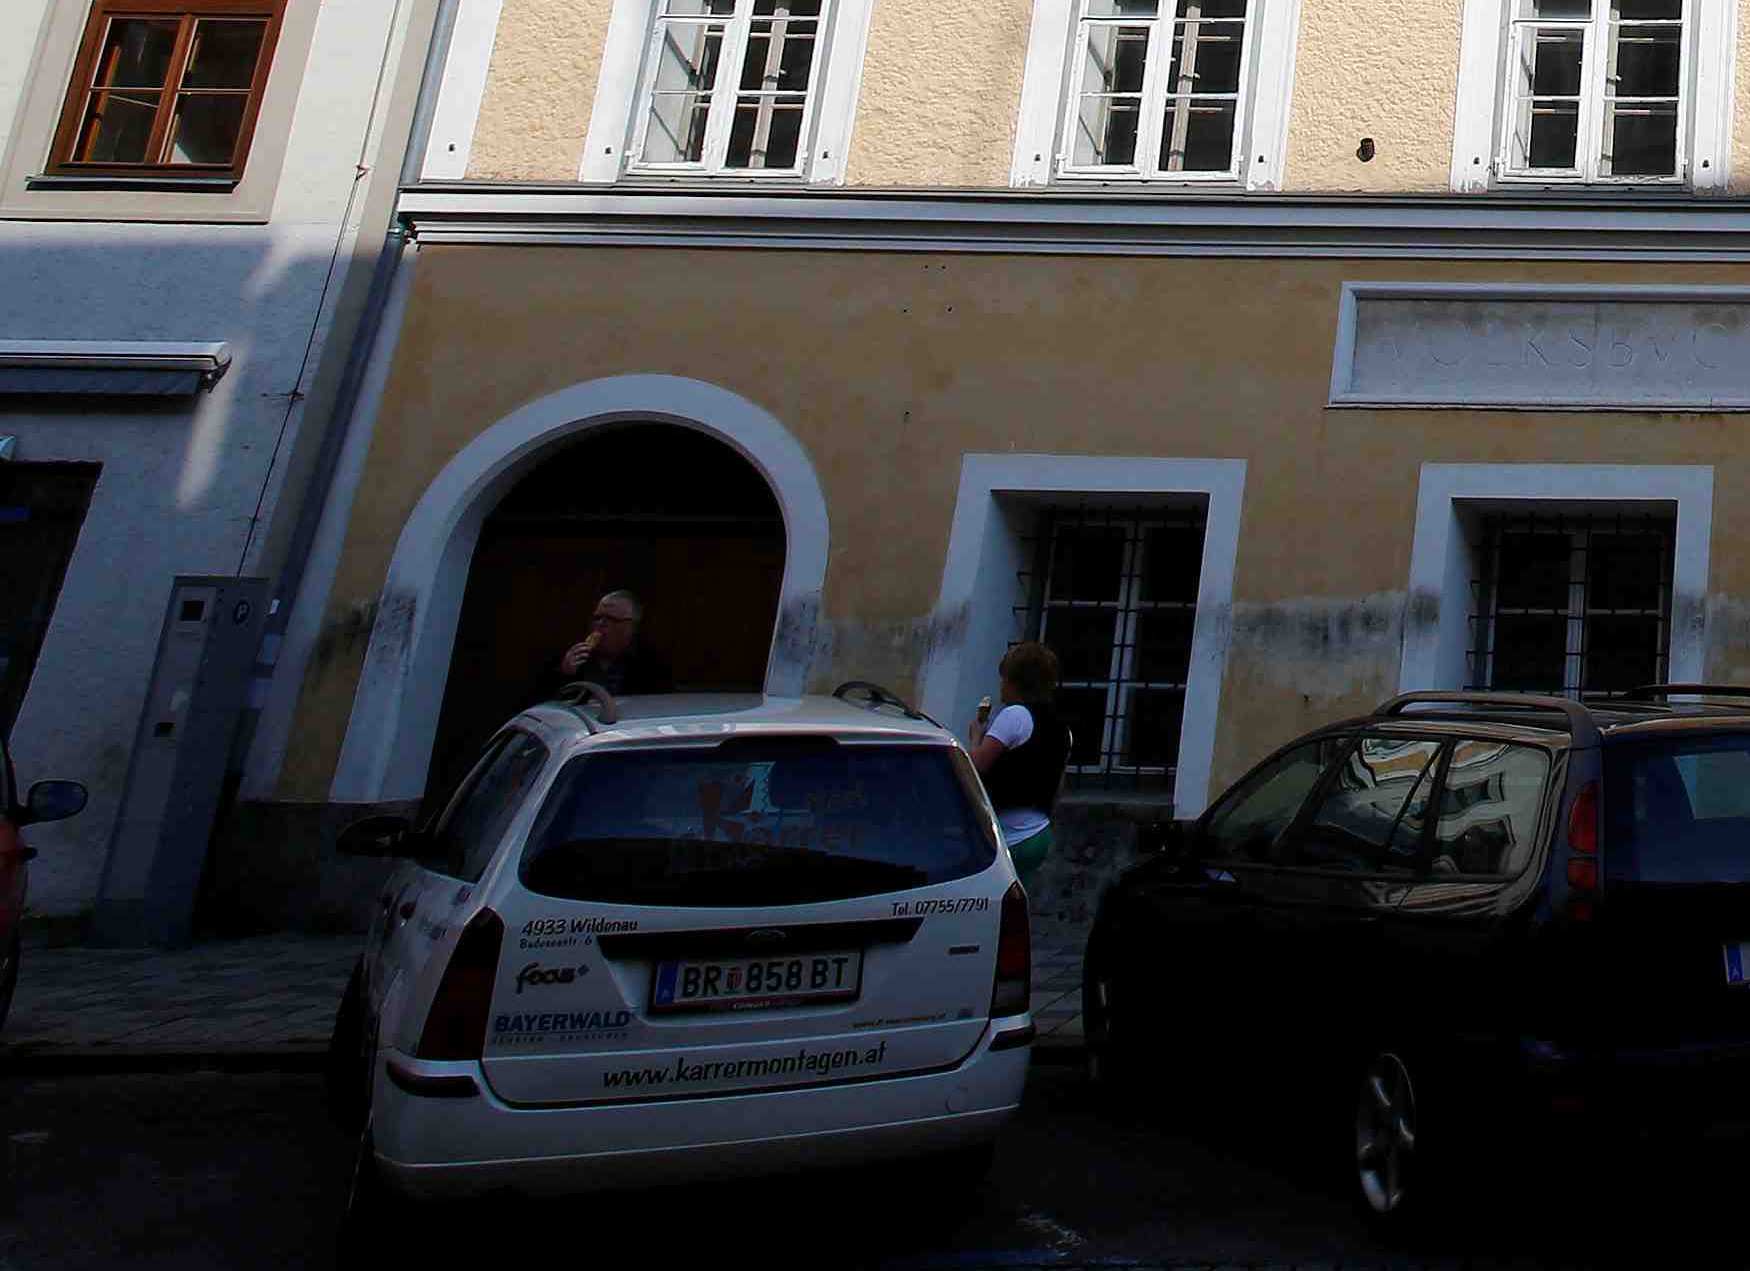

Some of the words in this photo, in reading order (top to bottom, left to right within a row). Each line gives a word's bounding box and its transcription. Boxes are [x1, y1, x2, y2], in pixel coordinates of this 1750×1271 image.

[520, 919, 567, 937] 4933
[682, 966, 721, 999] BR
[745, 959, 802, 994] 858
[811, 957, 849, 990] BT
[495, 1010, 630, 1033] BAYERWALD
[602, 1040, 888, 1088] www.karrermontagen.at
